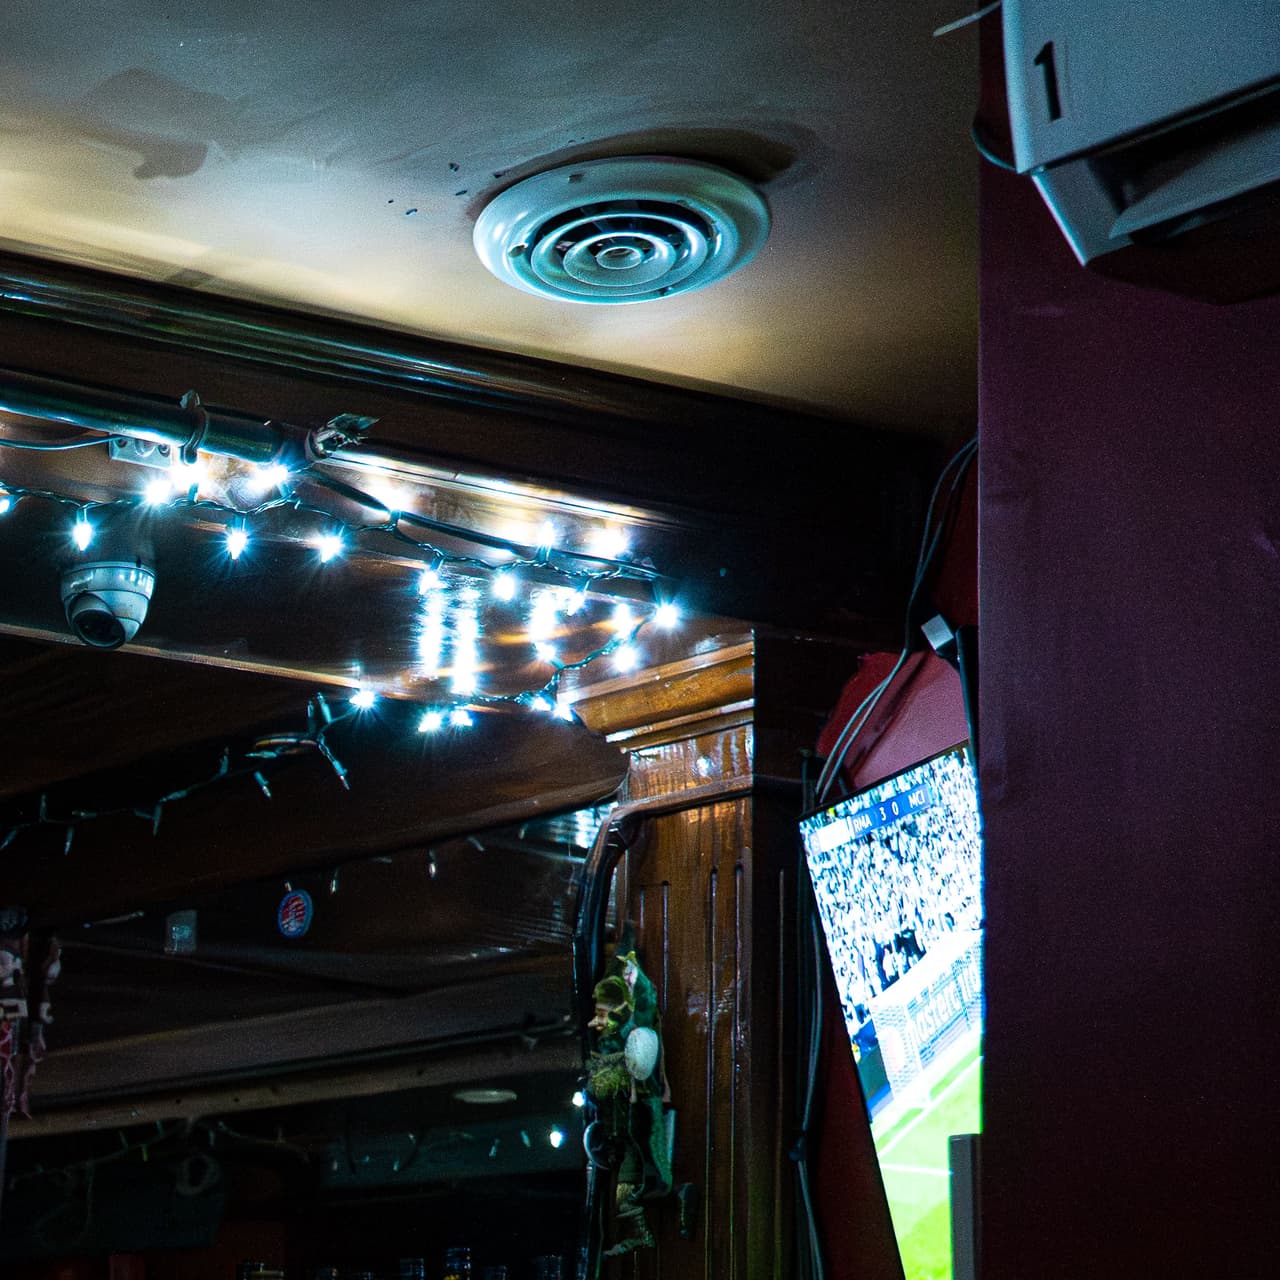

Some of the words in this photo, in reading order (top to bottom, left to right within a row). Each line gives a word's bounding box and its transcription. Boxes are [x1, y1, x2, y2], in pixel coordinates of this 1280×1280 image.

[1034, 41, 1062, 120] 1
[852, 814, 873, 833] RMA
[878, 807, 888, 822] 3
[891, 801, 900, 817] 0
[908, 790, 926, 809] MCI
